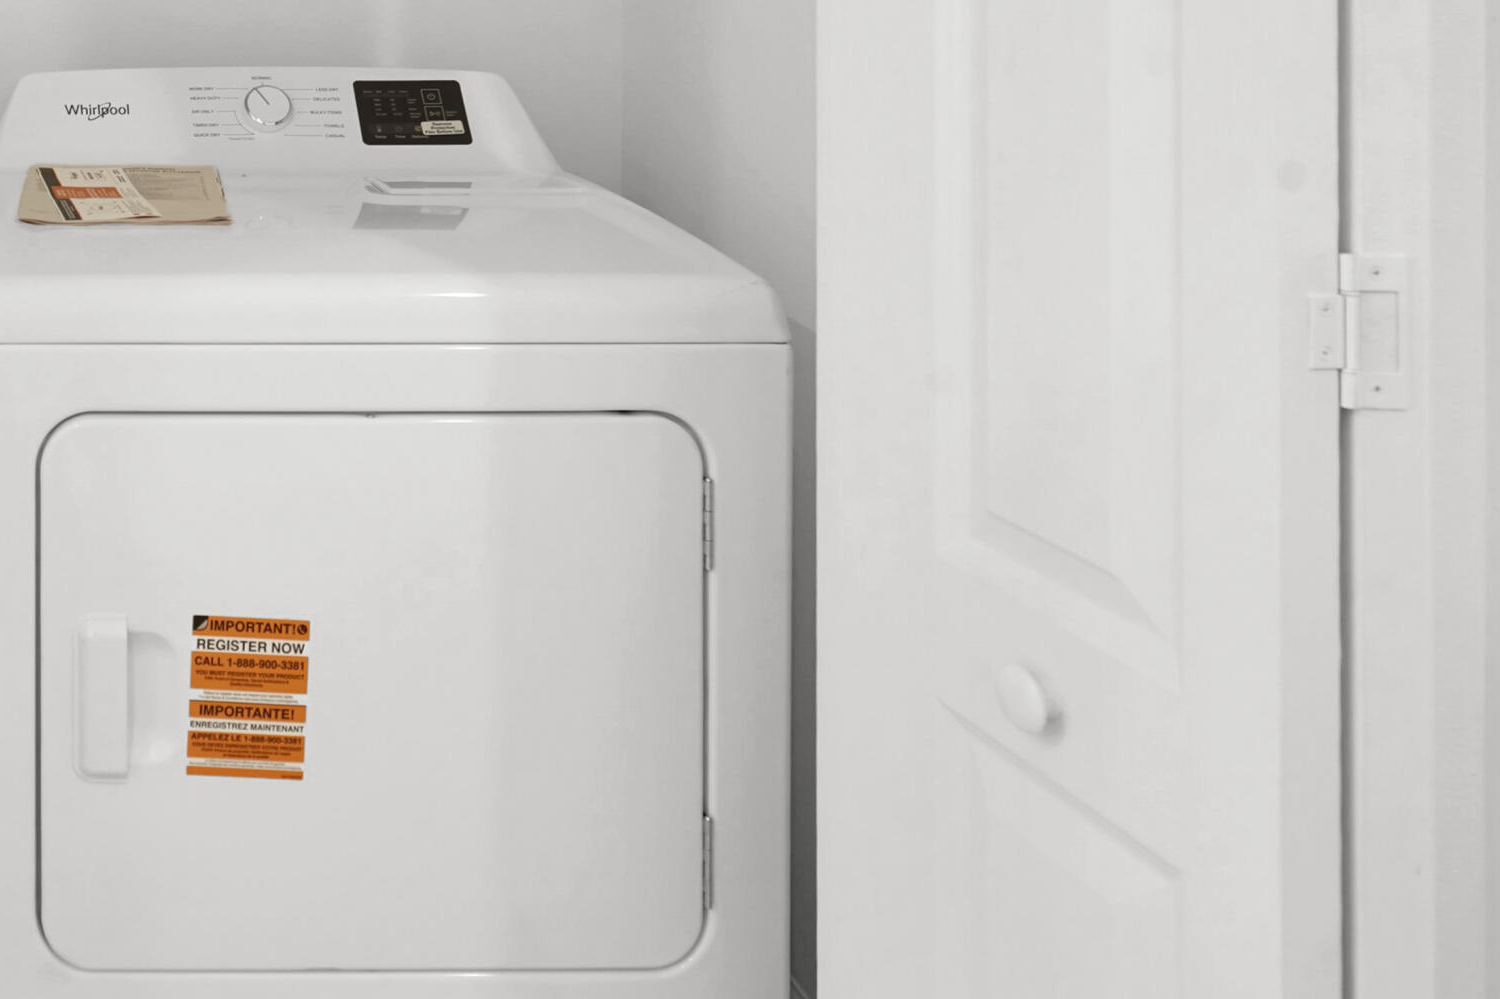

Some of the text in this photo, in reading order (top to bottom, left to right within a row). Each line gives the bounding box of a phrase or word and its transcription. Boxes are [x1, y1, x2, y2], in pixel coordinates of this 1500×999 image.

[64, 102, 130, 121] Whirlpool
[209, 619, 296, 635] IMPORTANT!
[196, 638, 306, 655] REGISTER NOW
[194, 656, 305, 671] CALL 1-888-900-3381
[199, 704, 295, 721] IMPORTANTE!
[190, 720, 304, 733] ENREGISTREZ MAINTENANT
